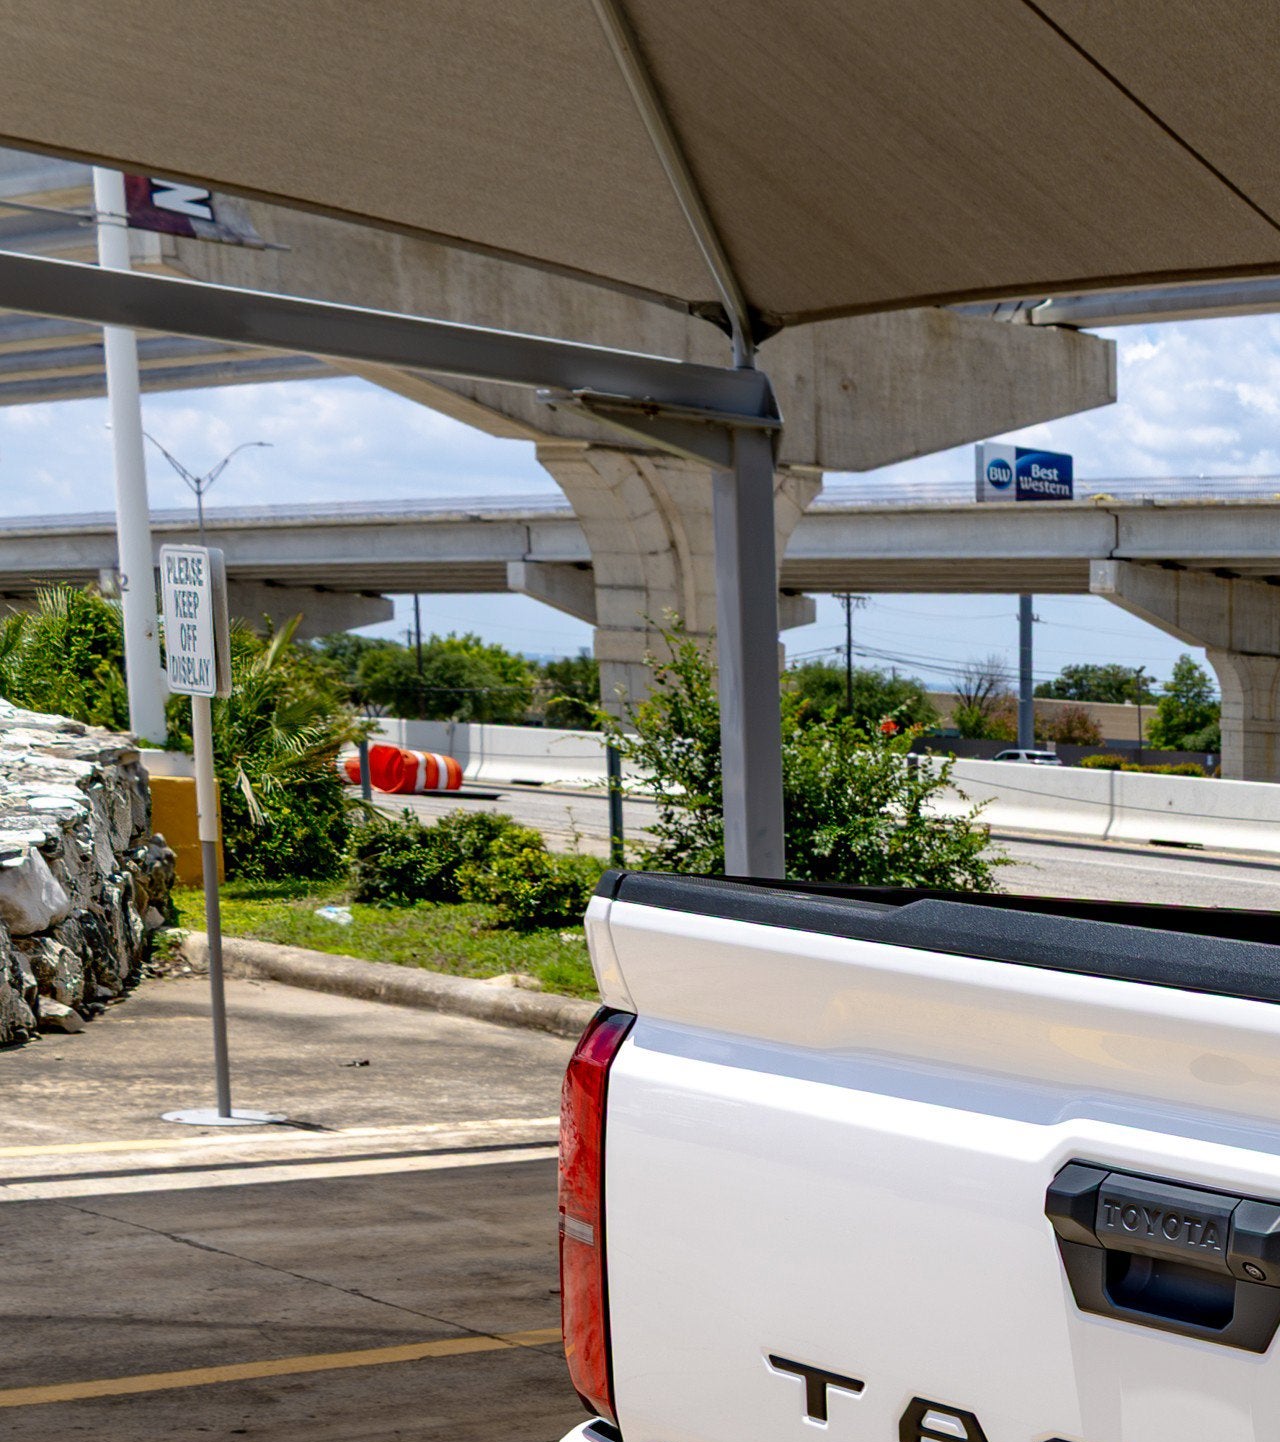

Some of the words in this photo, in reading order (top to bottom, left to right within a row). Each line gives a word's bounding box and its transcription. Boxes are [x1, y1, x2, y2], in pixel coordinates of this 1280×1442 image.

[989, 467, 1010, 483] BW
[1019, 476, 1070, 496] Western
[1031, 463, 1059, 481] Best
[166, 556, 204, 586] PLEASE
[174, 590, 200, 619] KEEP
[181, 623, 197, 652] OFF
[171, 655, 210, 687] DISPLAY
[1103, 1200, 1223, 1251] TOYOTA
